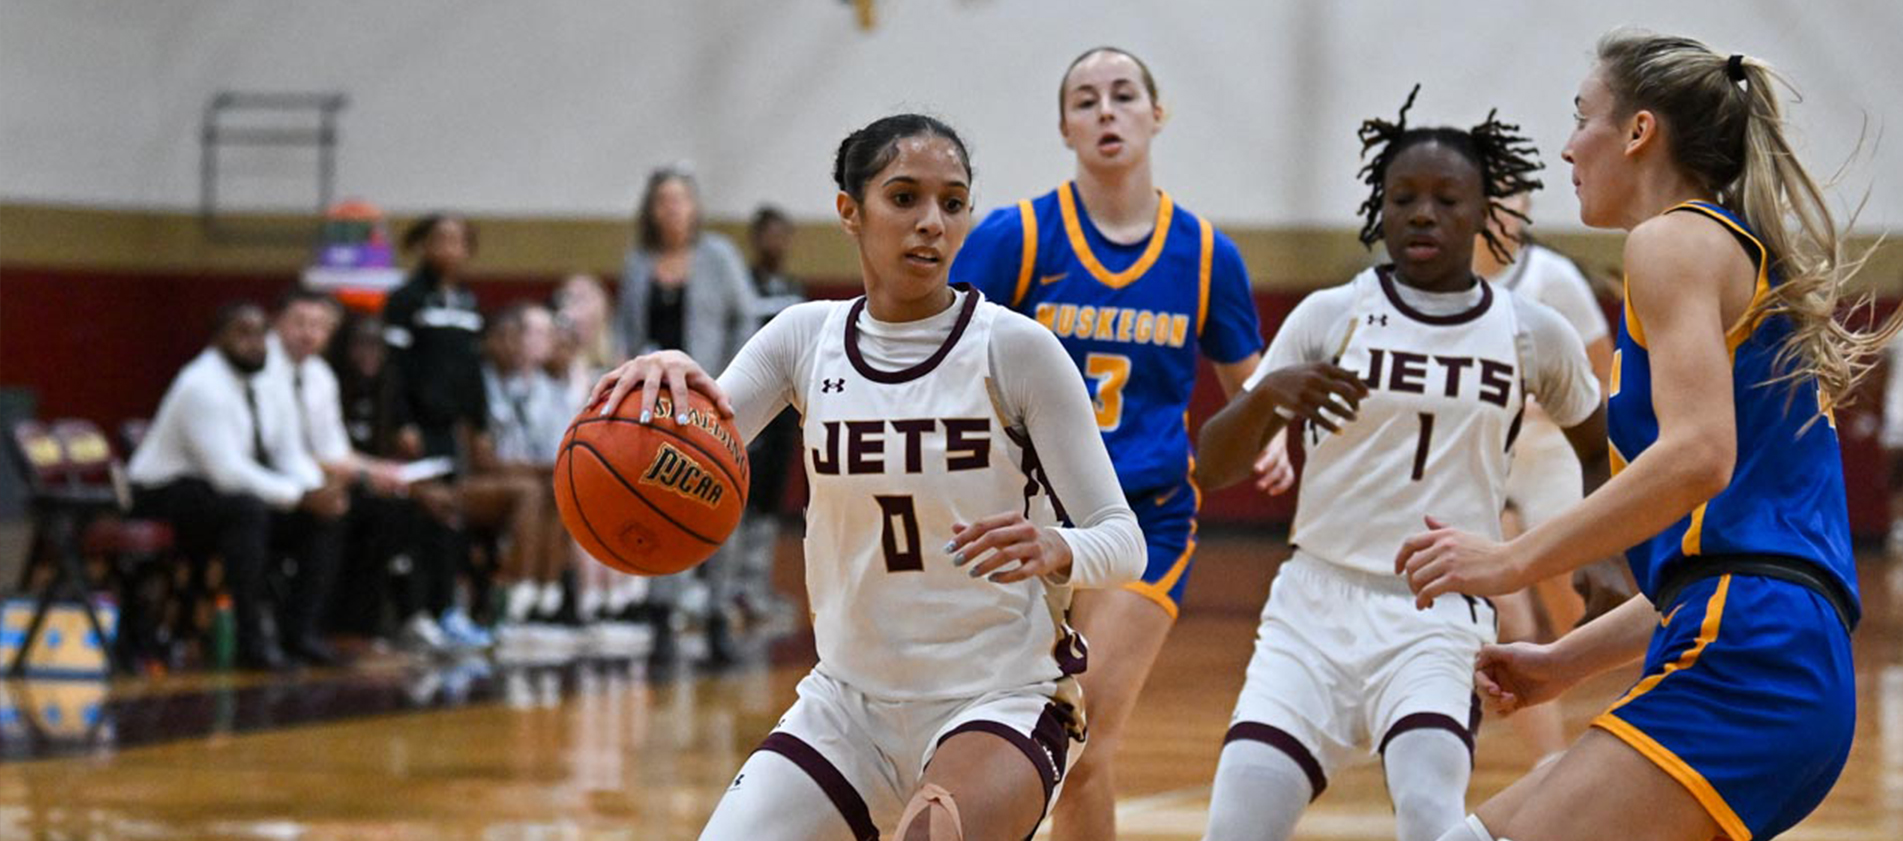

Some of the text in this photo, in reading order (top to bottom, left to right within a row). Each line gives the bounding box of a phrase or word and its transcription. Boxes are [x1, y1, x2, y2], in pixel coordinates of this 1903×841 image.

[1035, 302, 1189, 348] MUSKEGON
[1086, 352, 1131, 432] 3
[1354, 348, 1514, 408] JETS
[812, 417, 991, 475] JETS
[1411, 412, 1435, 481] 1
[873, 495, 925, 573] 0
